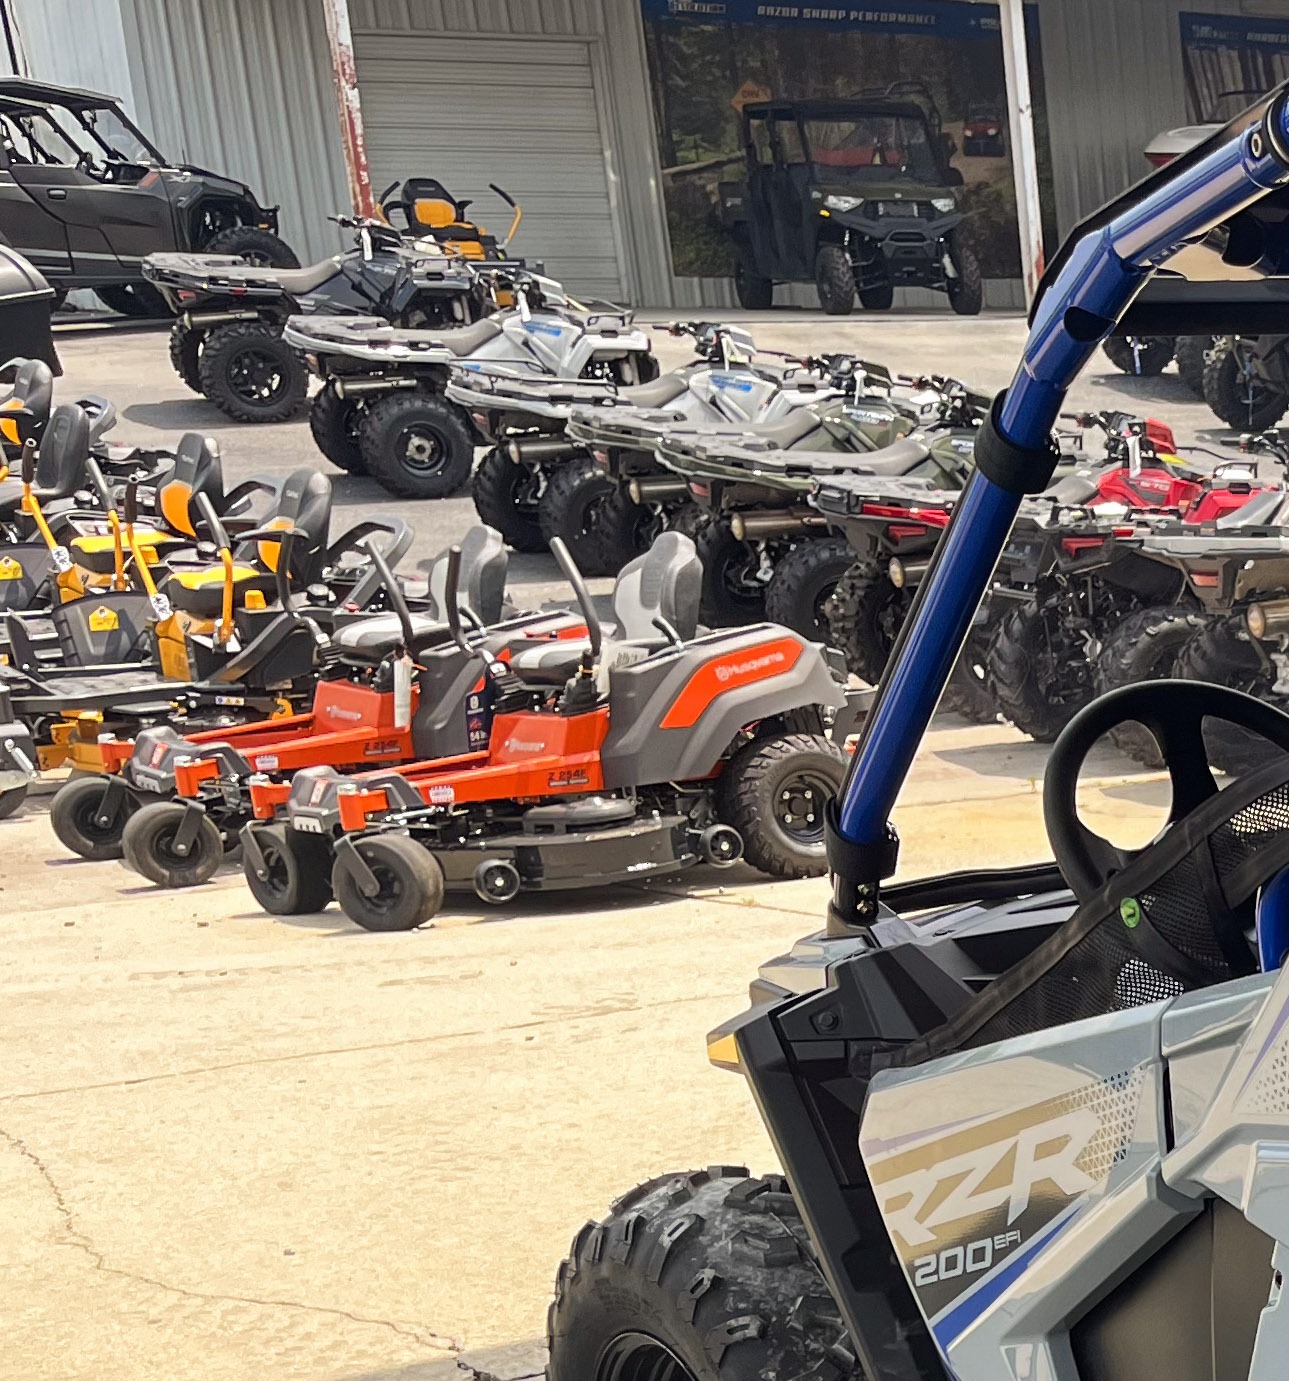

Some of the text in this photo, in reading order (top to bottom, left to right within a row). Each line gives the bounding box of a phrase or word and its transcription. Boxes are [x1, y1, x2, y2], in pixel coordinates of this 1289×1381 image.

[802, 8, 846, 20] SHARP
[874, 1108, 1098, 1246] RZR
[914, 1229, 1021, 1287] 200 EFI
